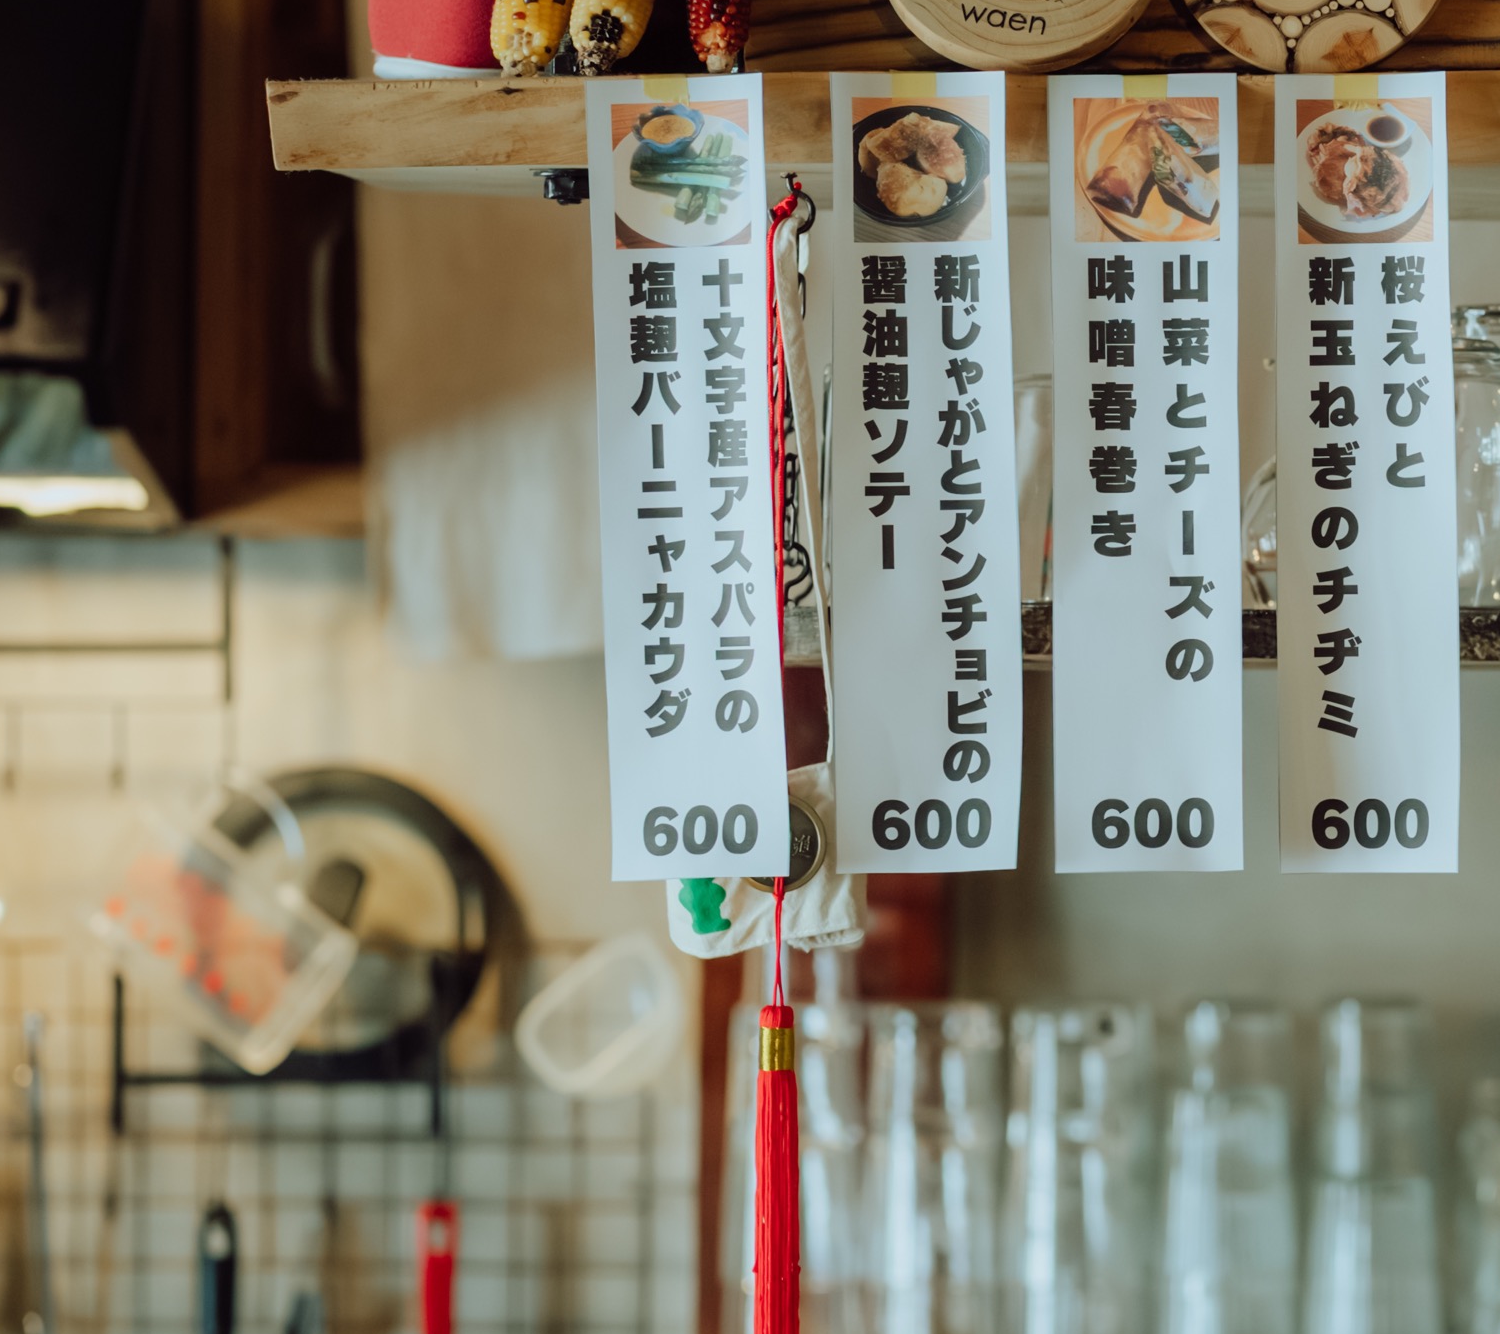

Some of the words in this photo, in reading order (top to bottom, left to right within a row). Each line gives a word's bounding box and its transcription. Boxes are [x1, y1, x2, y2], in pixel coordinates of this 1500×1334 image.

[961, 3, 1047, 35] waen
[629, 261, 691, 737] 塩麹バーニャカウダ
[702, 259, 758, 733] 十文字産アスパラの
[861, 255, 910, 569] 醤油麹ソテー
[934, 255, 992, 783] 新じゃがとアンチョビの
[1088, 255, 1137, 557] 味噌春巻き
[1162, 256, 1215, 682] 山菜とチーズの
[1309, 257, 1362, 738] 新玉ねぎのチヂミ
[1381, 256, 1429, 488] 桜えびと
[643, 804, 758, 856] 600
[872, 799, 991, 850] 600
[1092, 798, 1214, 849] 600
[1311, 798, 1428, 849] 600
